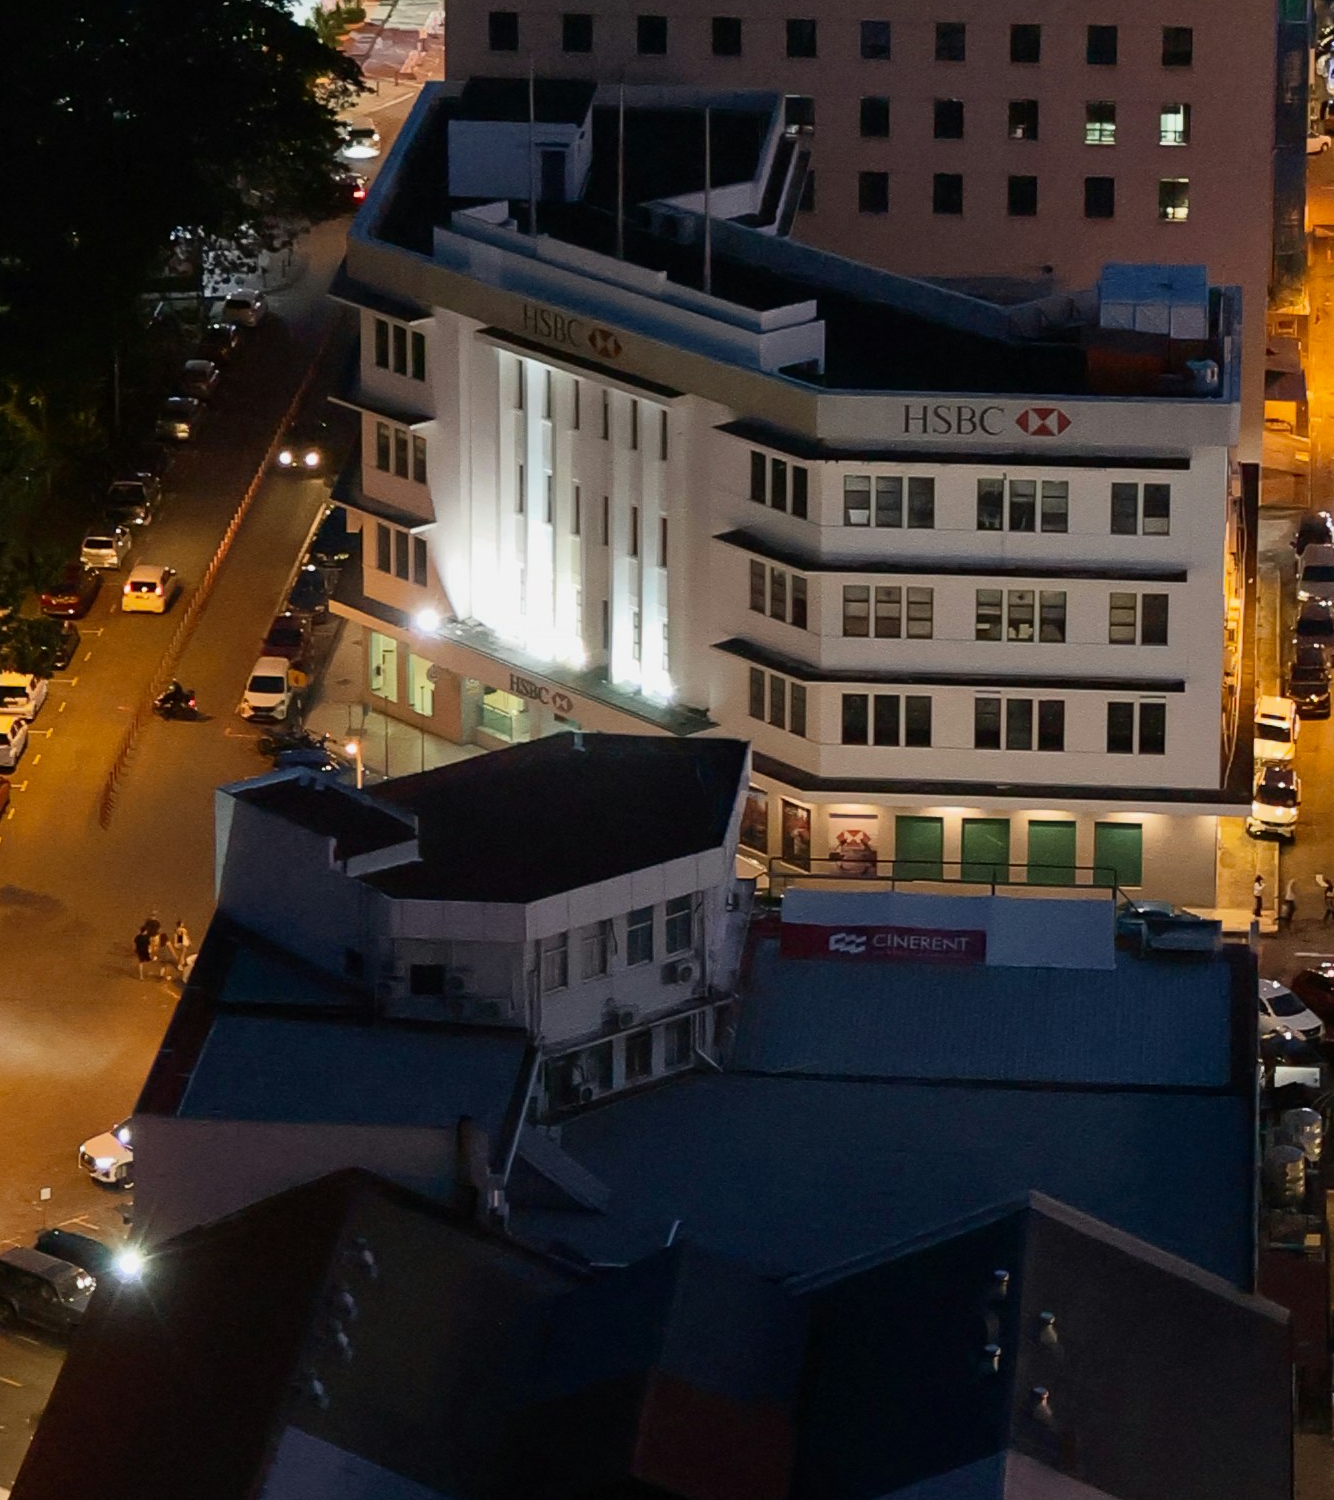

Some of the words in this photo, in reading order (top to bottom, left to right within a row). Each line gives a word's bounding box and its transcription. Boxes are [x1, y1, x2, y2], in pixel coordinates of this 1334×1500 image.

[523, 304, 584, 348] HSBC
[903, 404, 1005, 436] HSBC
[509, 674, 549, 705] HSBC
[872, 933, 970, 952] CINERENT
